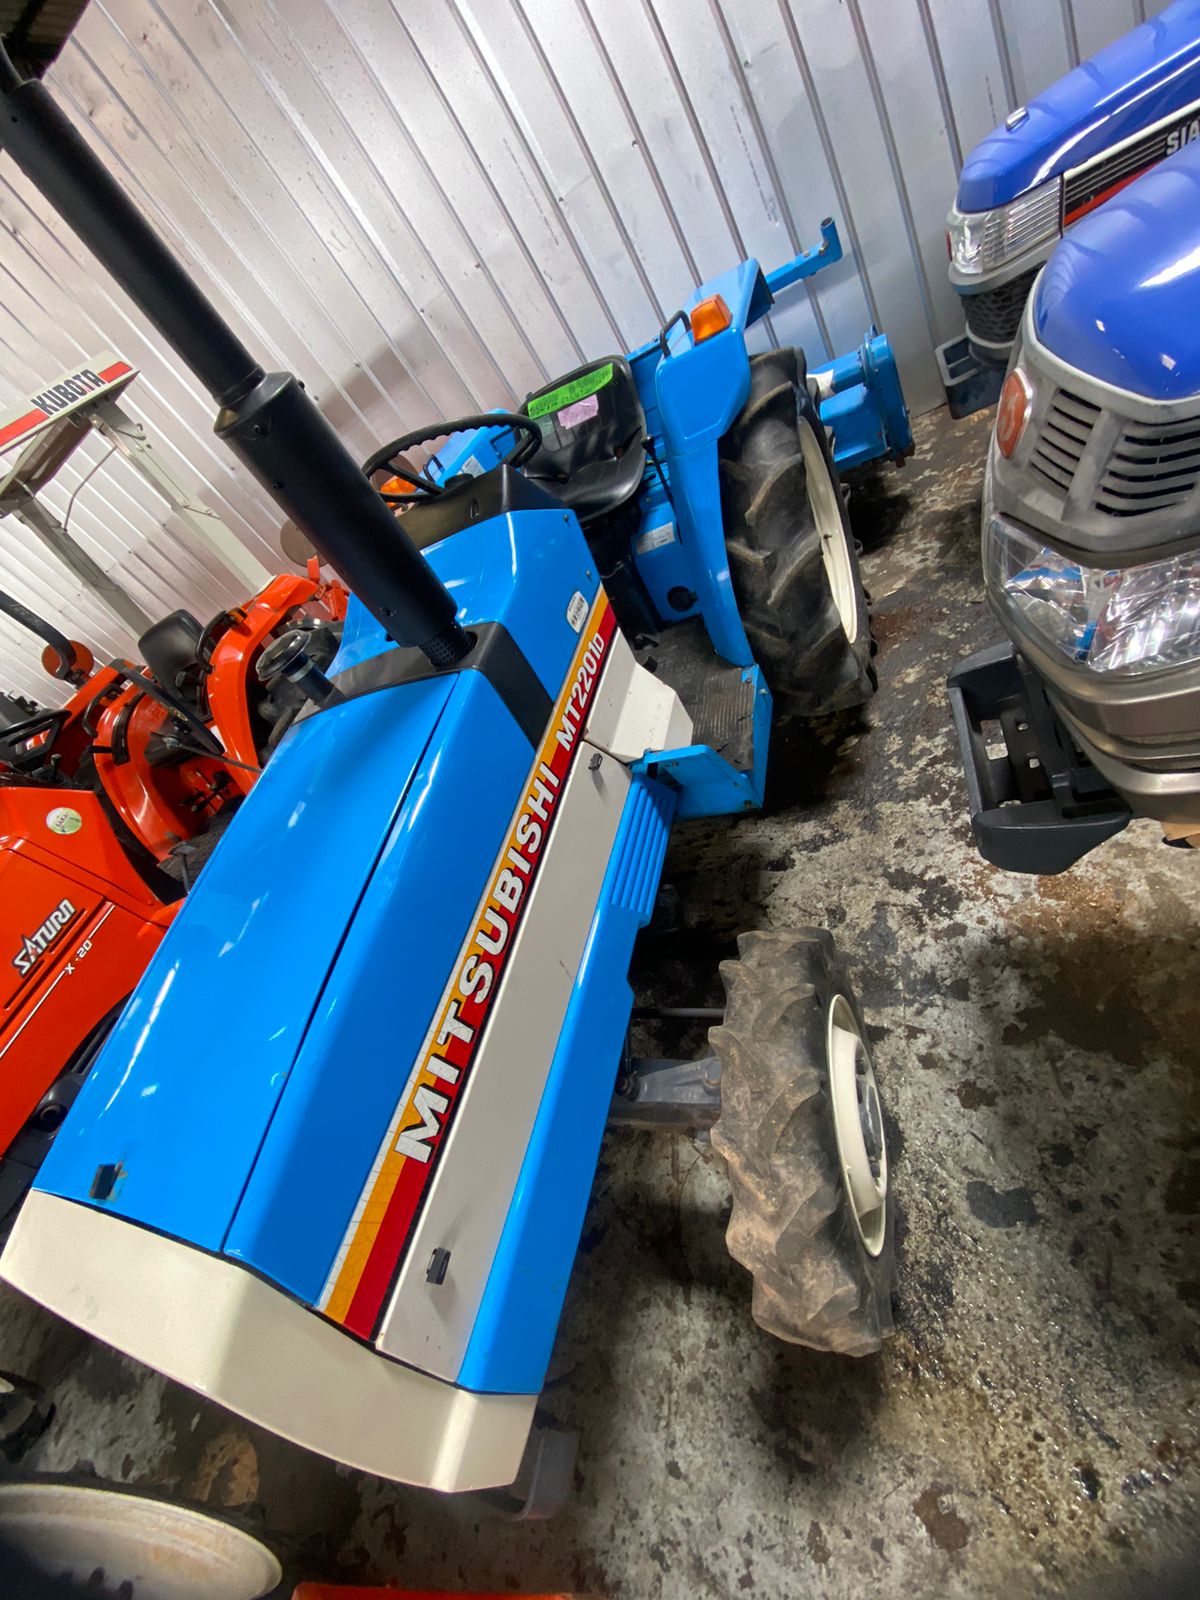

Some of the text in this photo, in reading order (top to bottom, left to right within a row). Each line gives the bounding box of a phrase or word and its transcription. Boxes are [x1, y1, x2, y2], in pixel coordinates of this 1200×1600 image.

[30, 369, 106, 416] KUBOTA
[555, 632, 605, 752] MT2201D
[13, 899, 76, 976] SATURN
[394, 762, 560, 1163] MITSUBISHI
